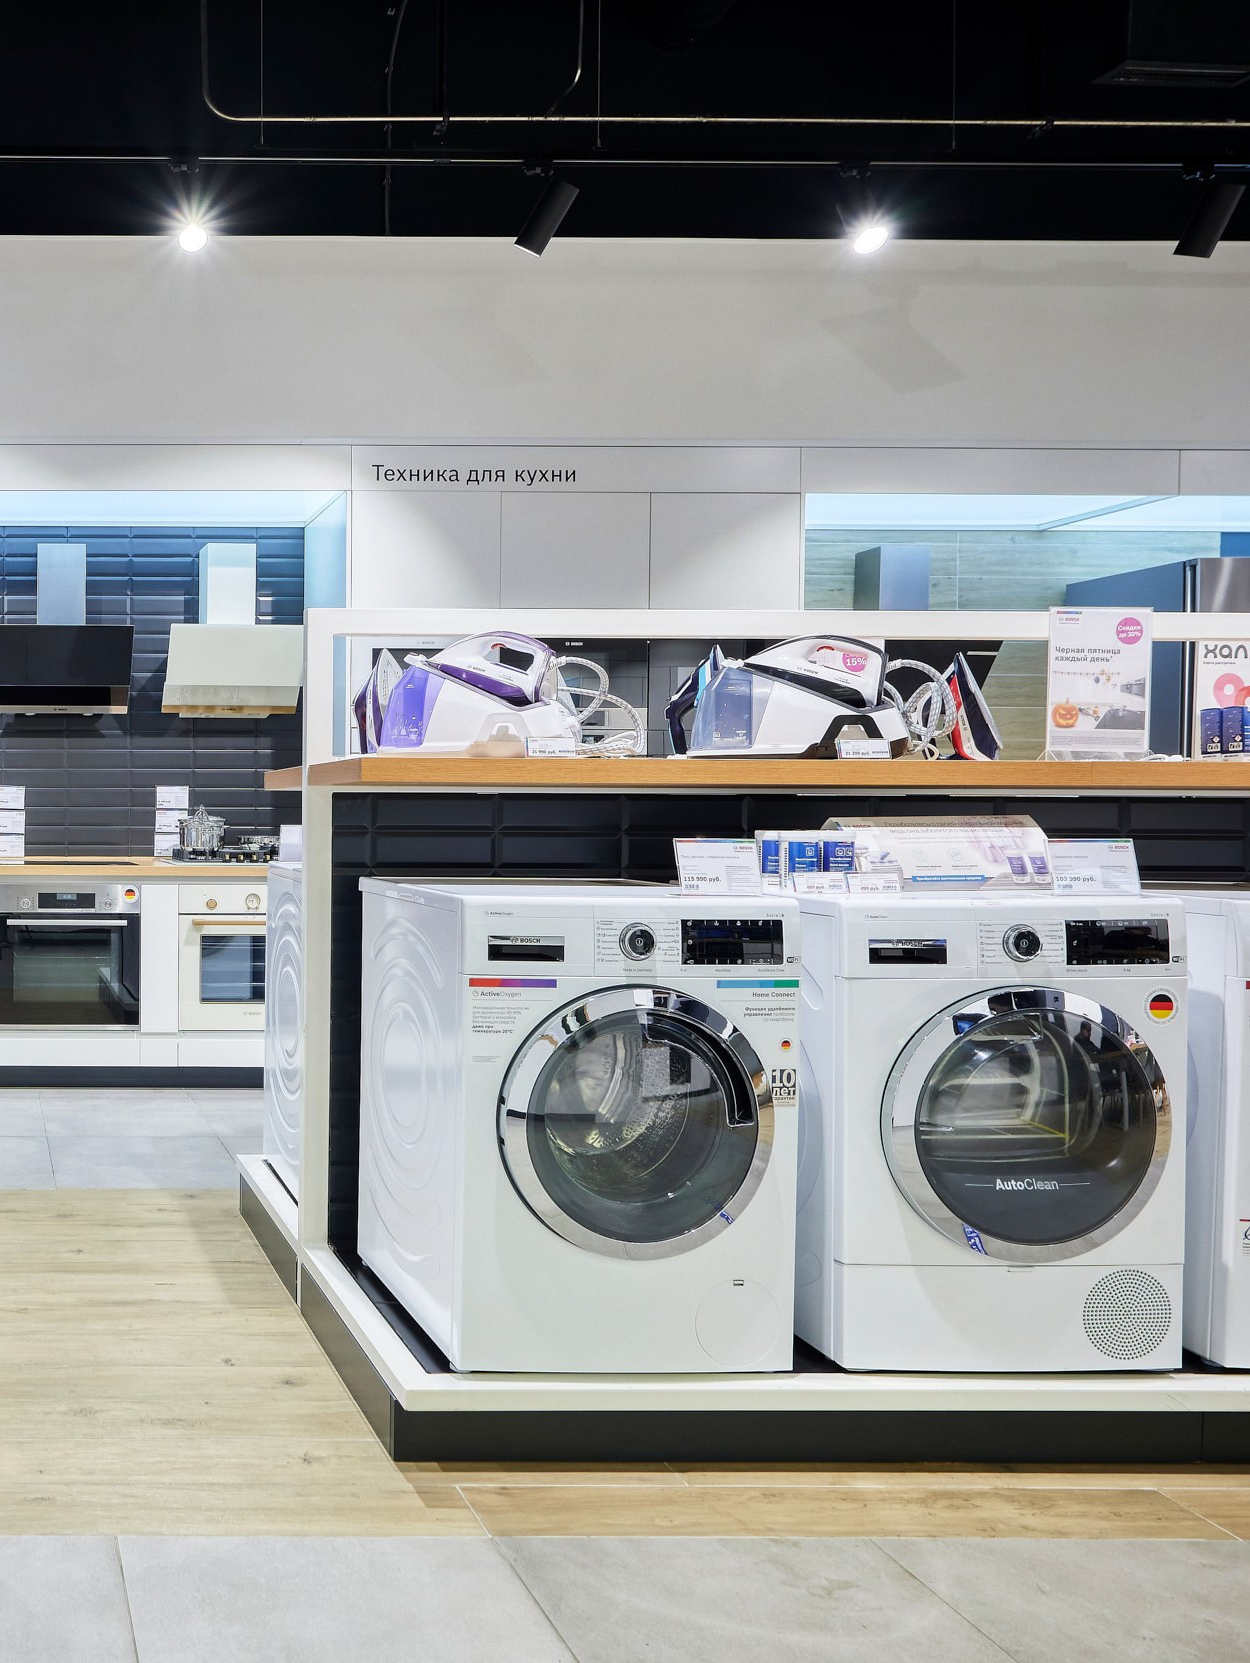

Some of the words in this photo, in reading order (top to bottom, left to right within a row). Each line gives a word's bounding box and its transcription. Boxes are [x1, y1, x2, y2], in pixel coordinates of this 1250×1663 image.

[372, 464, 459, 482] Техника
[467, 469, 505, 485] для
[515, 469, 576, 486] кухни
[1055, 646, 1085, 655] Черная
[1087, 648, 1121, 656] пятница
[845, 657, 867, 666] 15%
[1055, 654, 1088, 663] каждый
[480, 990, 522, 998] ActiveOxygen
[772, 1069, 796, 1088] 10
[772, 1087, 796, 1096] лет
[996, 1178, 1059, 1191] AutoClean
